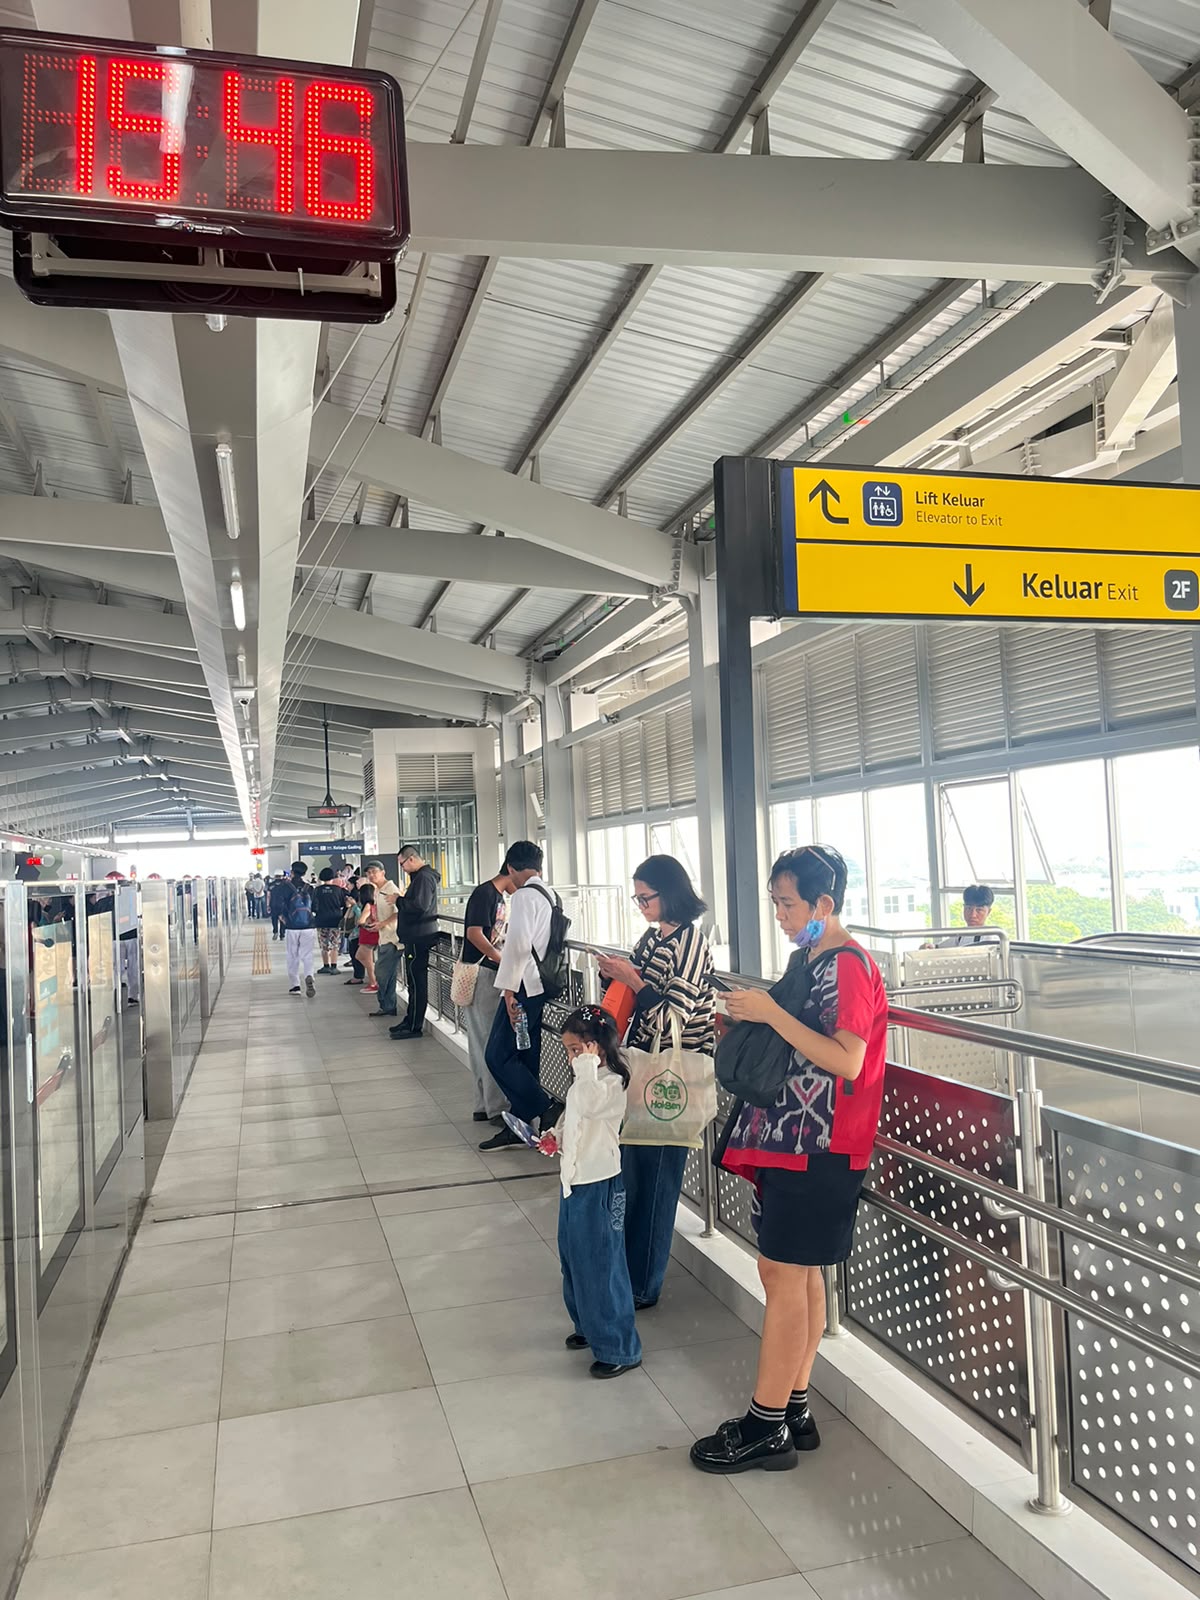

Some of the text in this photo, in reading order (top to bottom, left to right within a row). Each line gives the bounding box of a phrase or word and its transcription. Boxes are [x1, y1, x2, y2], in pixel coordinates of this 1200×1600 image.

[915, 491, 985, 507] Lift Keluar
[916, 511, 1003, 527] Elevator to Exit
[1022, 573, 1139, 601] Keluar Exit
[1171, 580, 1191, 599] 2F
